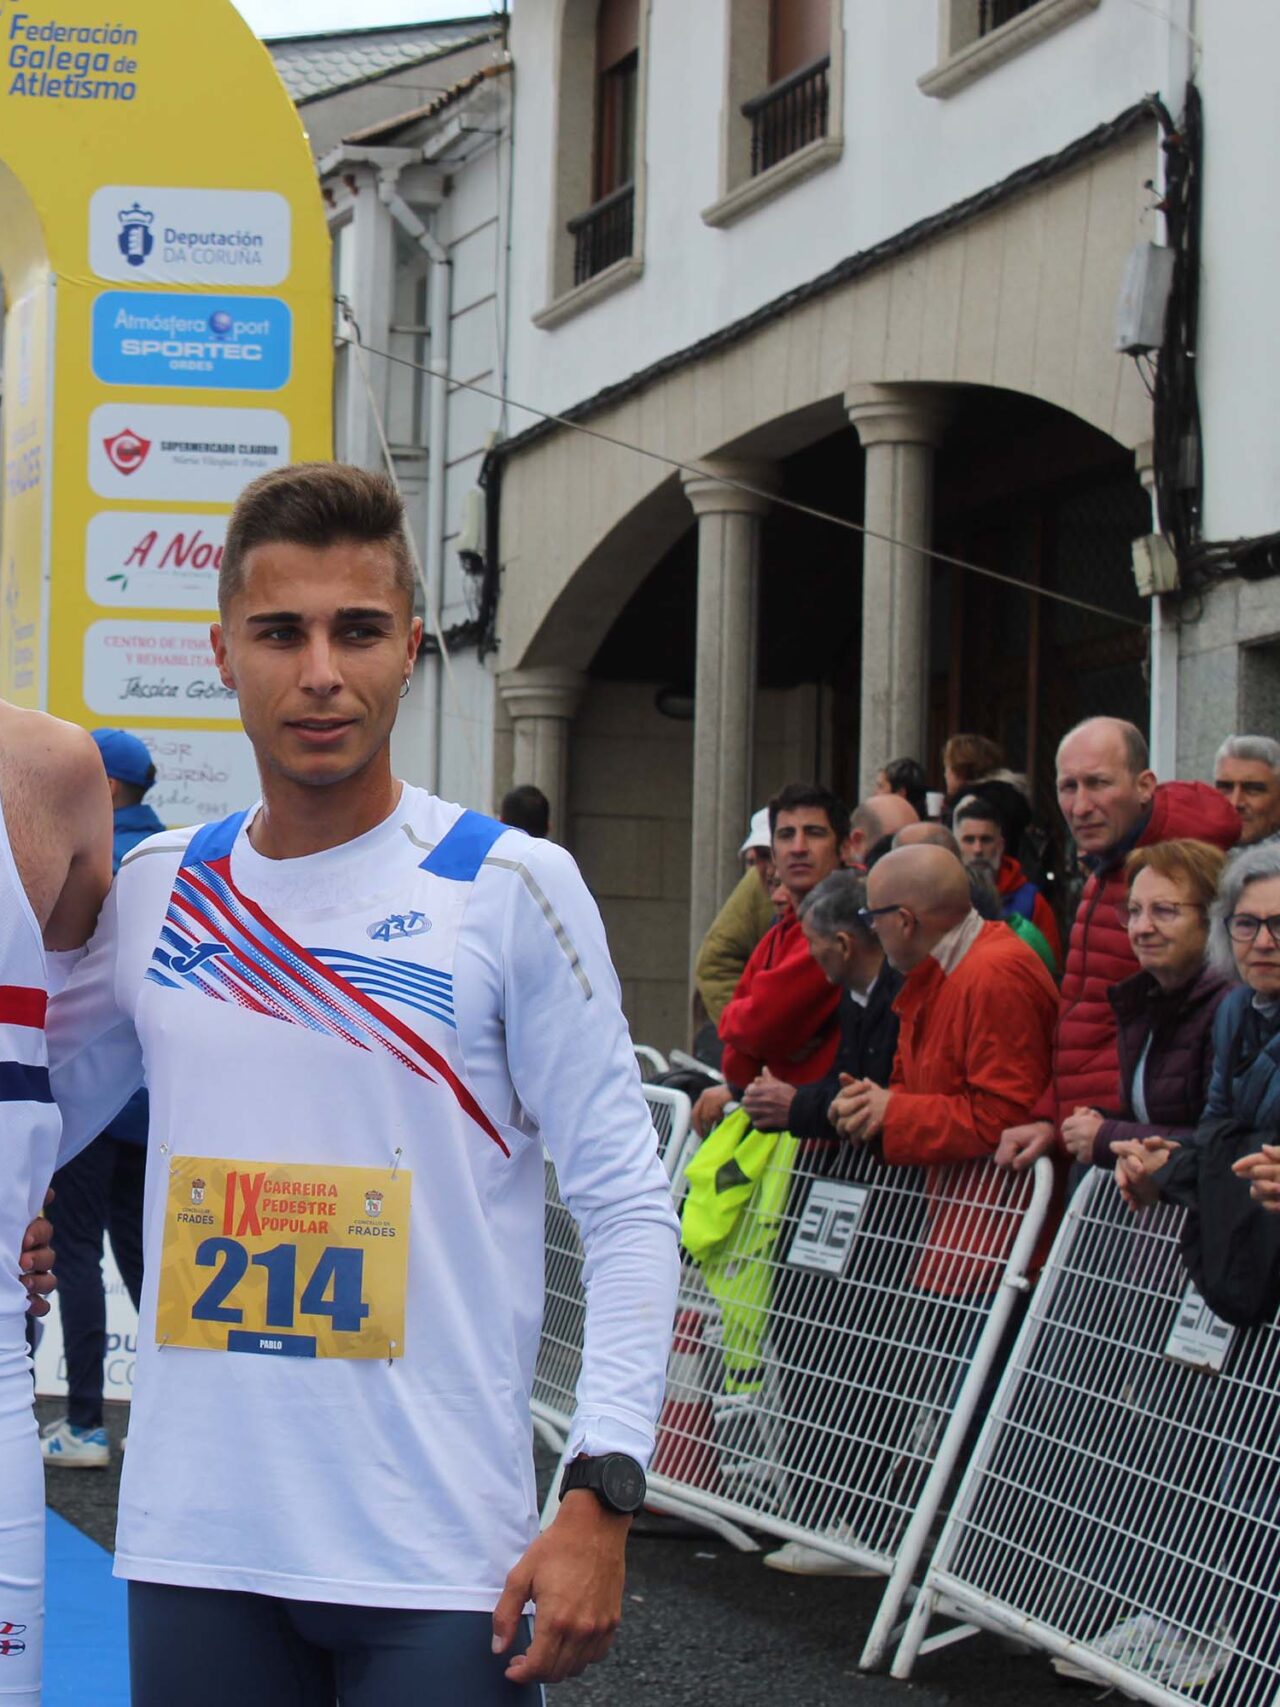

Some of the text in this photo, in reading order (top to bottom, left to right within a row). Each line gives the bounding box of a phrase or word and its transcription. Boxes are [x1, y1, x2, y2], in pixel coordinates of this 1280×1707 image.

[9, 14, 137, 45] Federación
[9, 45, 137, 78] Galega de
[9, 73, 136, 100] Atletismo
[164, 228, 263, 247] Deputación
[163, 247, 262, 265] DA CORUÑA
[121, 339, 262, 361] SPORTEC
[123, 530, 158, 567] A
[104, 636, 156, 648] CENTRO
[160, 637, 174, 649] DE
[264, 1179, 338, 1197] CARREIRA
[223, 1171, 266, 1237] IX
[262, 1198, 336, 1216] PEDESTRE
[177, 1212, 214, 1225] FRADES
[261, 1216, 329, 1234] POPULAR
[348, 1225, 396, 1238] FRADES
[191, 1237, 369, 1332] 214
[259, 1339, 282, 1350] PABLO
